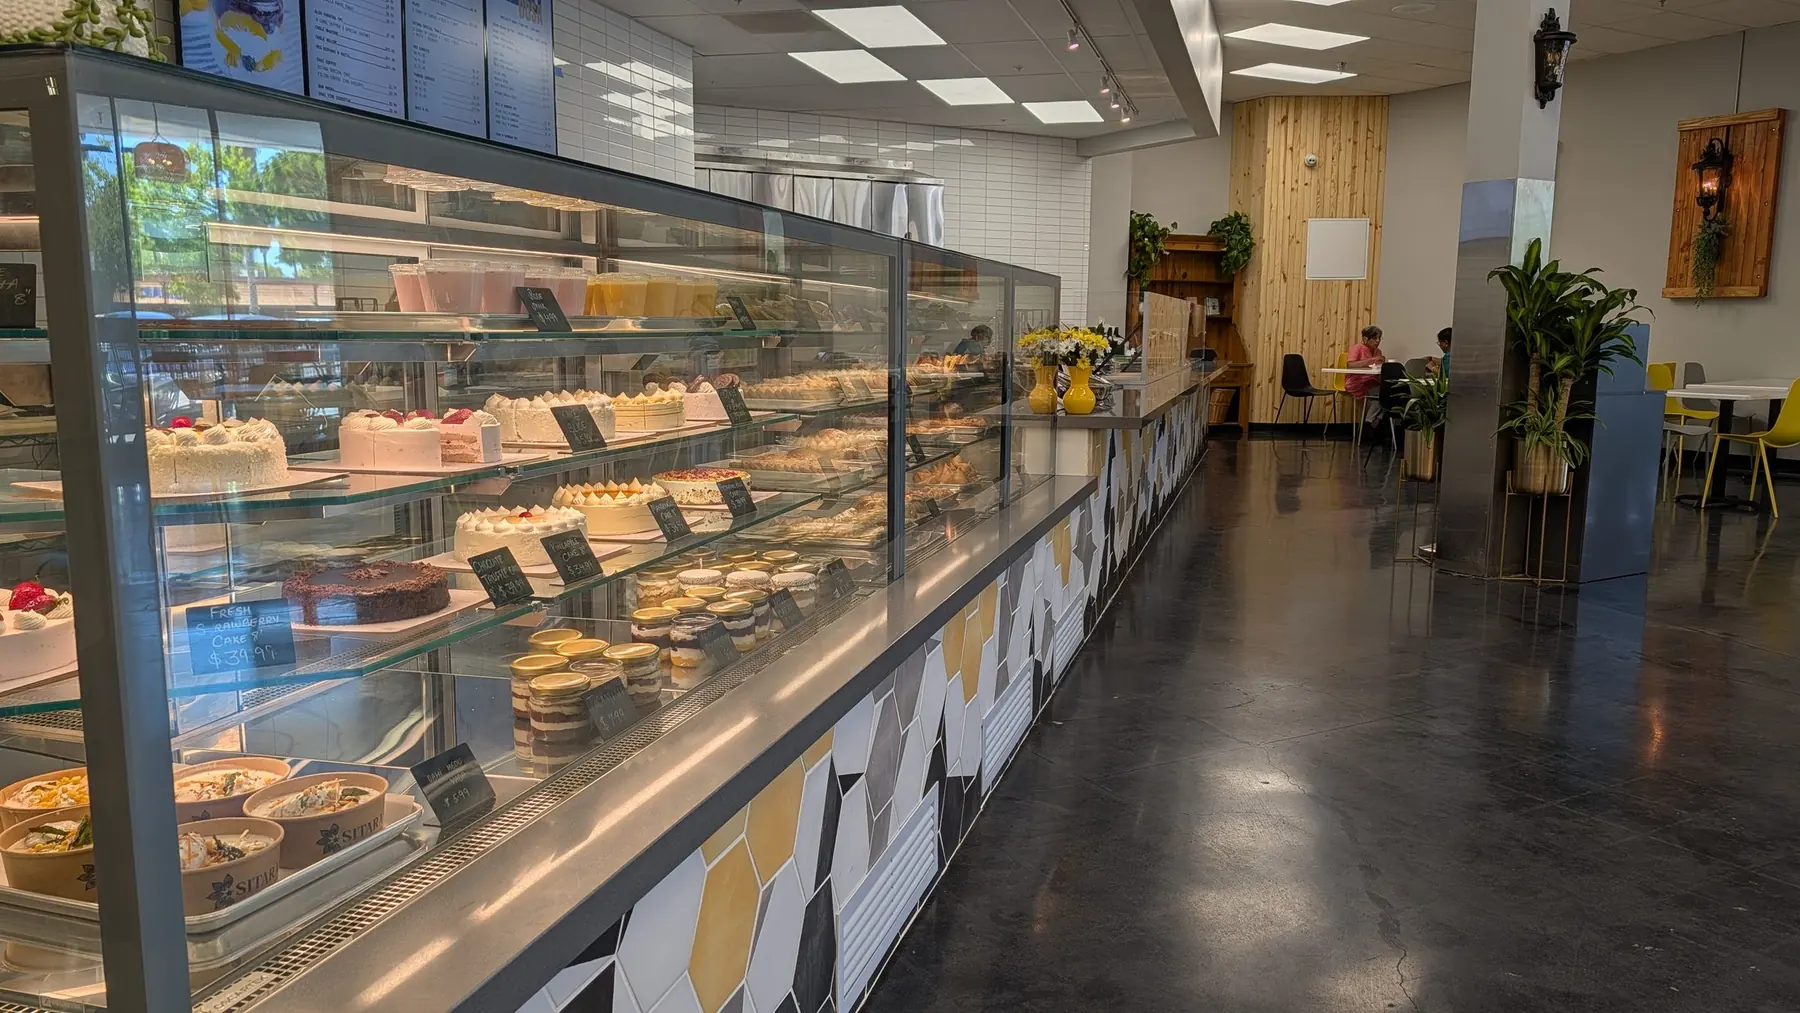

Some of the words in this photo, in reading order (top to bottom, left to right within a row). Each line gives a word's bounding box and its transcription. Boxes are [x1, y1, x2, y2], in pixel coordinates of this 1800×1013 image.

[210, 605, 252, 619] FRESH
[195, 615, 279, 636] SRAWBERRY
[212, 634, 247, 648] CAKE
